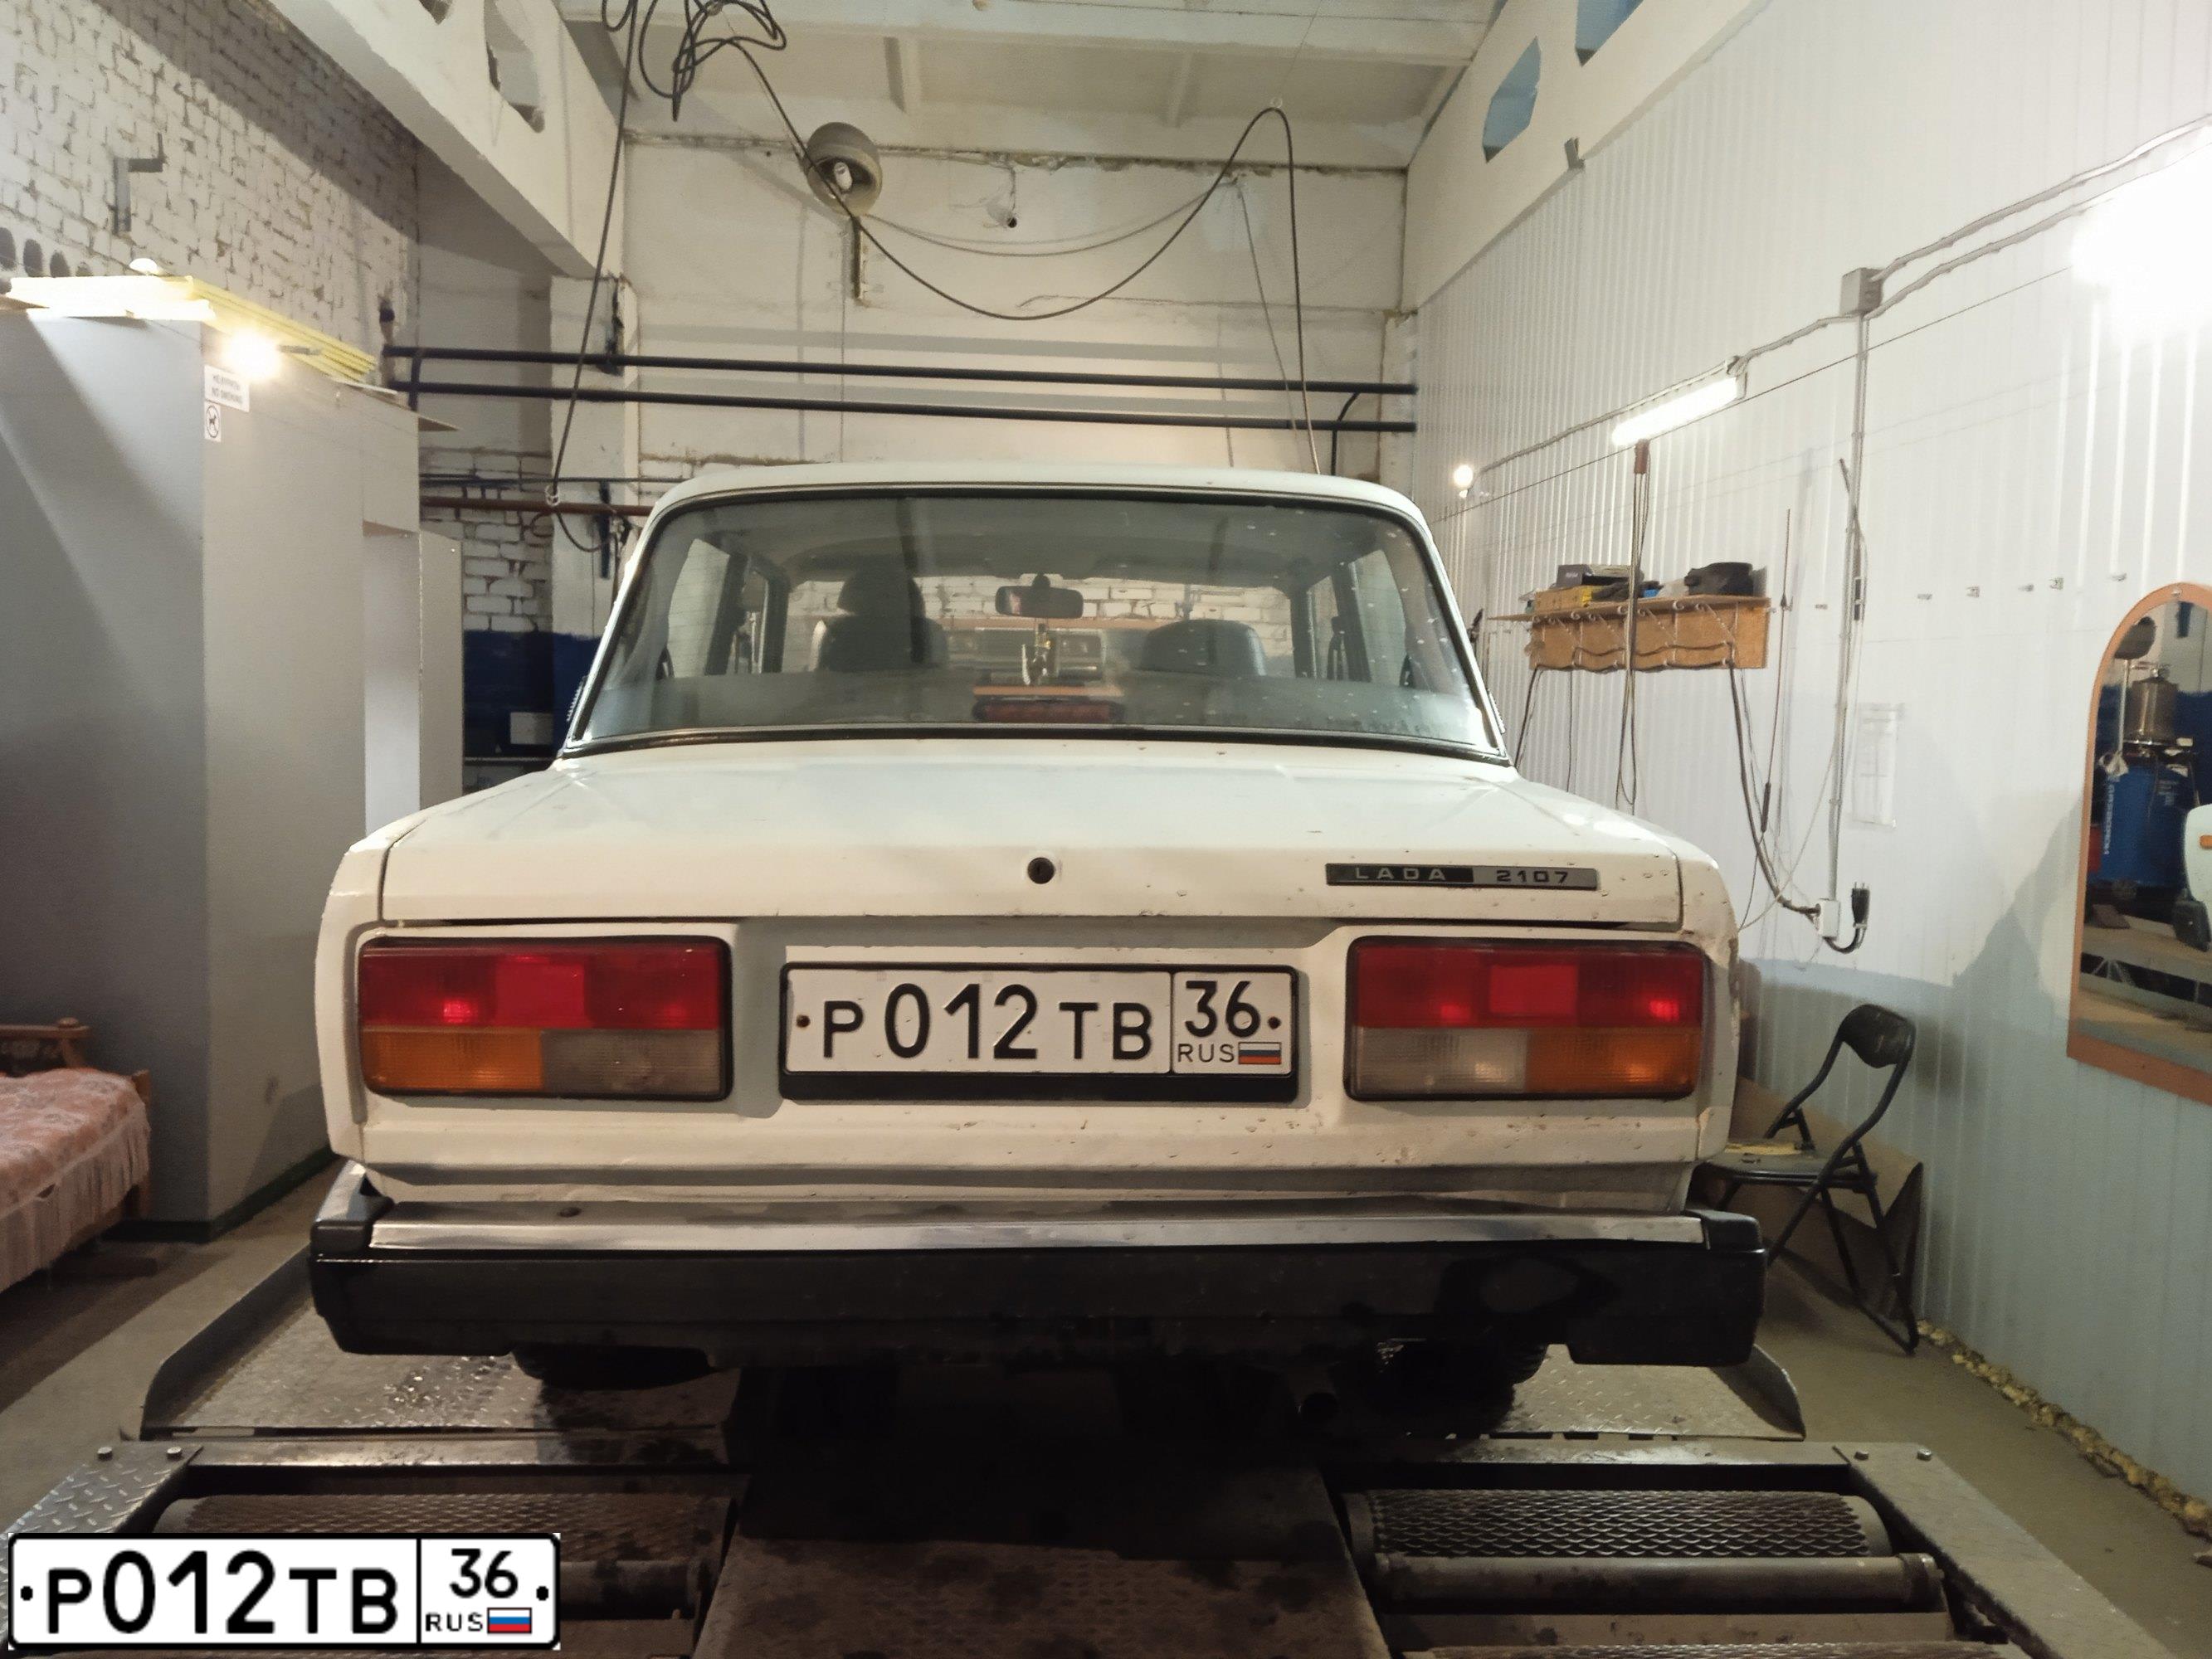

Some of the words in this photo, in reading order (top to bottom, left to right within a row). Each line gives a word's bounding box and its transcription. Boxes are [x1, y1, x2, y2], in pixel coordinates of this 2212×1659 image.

[1355, 867, 1446, 881] LADA
[1496, 869, 1569, 884] 2107
[1185, 980, 1261, 1038] 36
[1177, 1043, 1235, 1063] RUS
